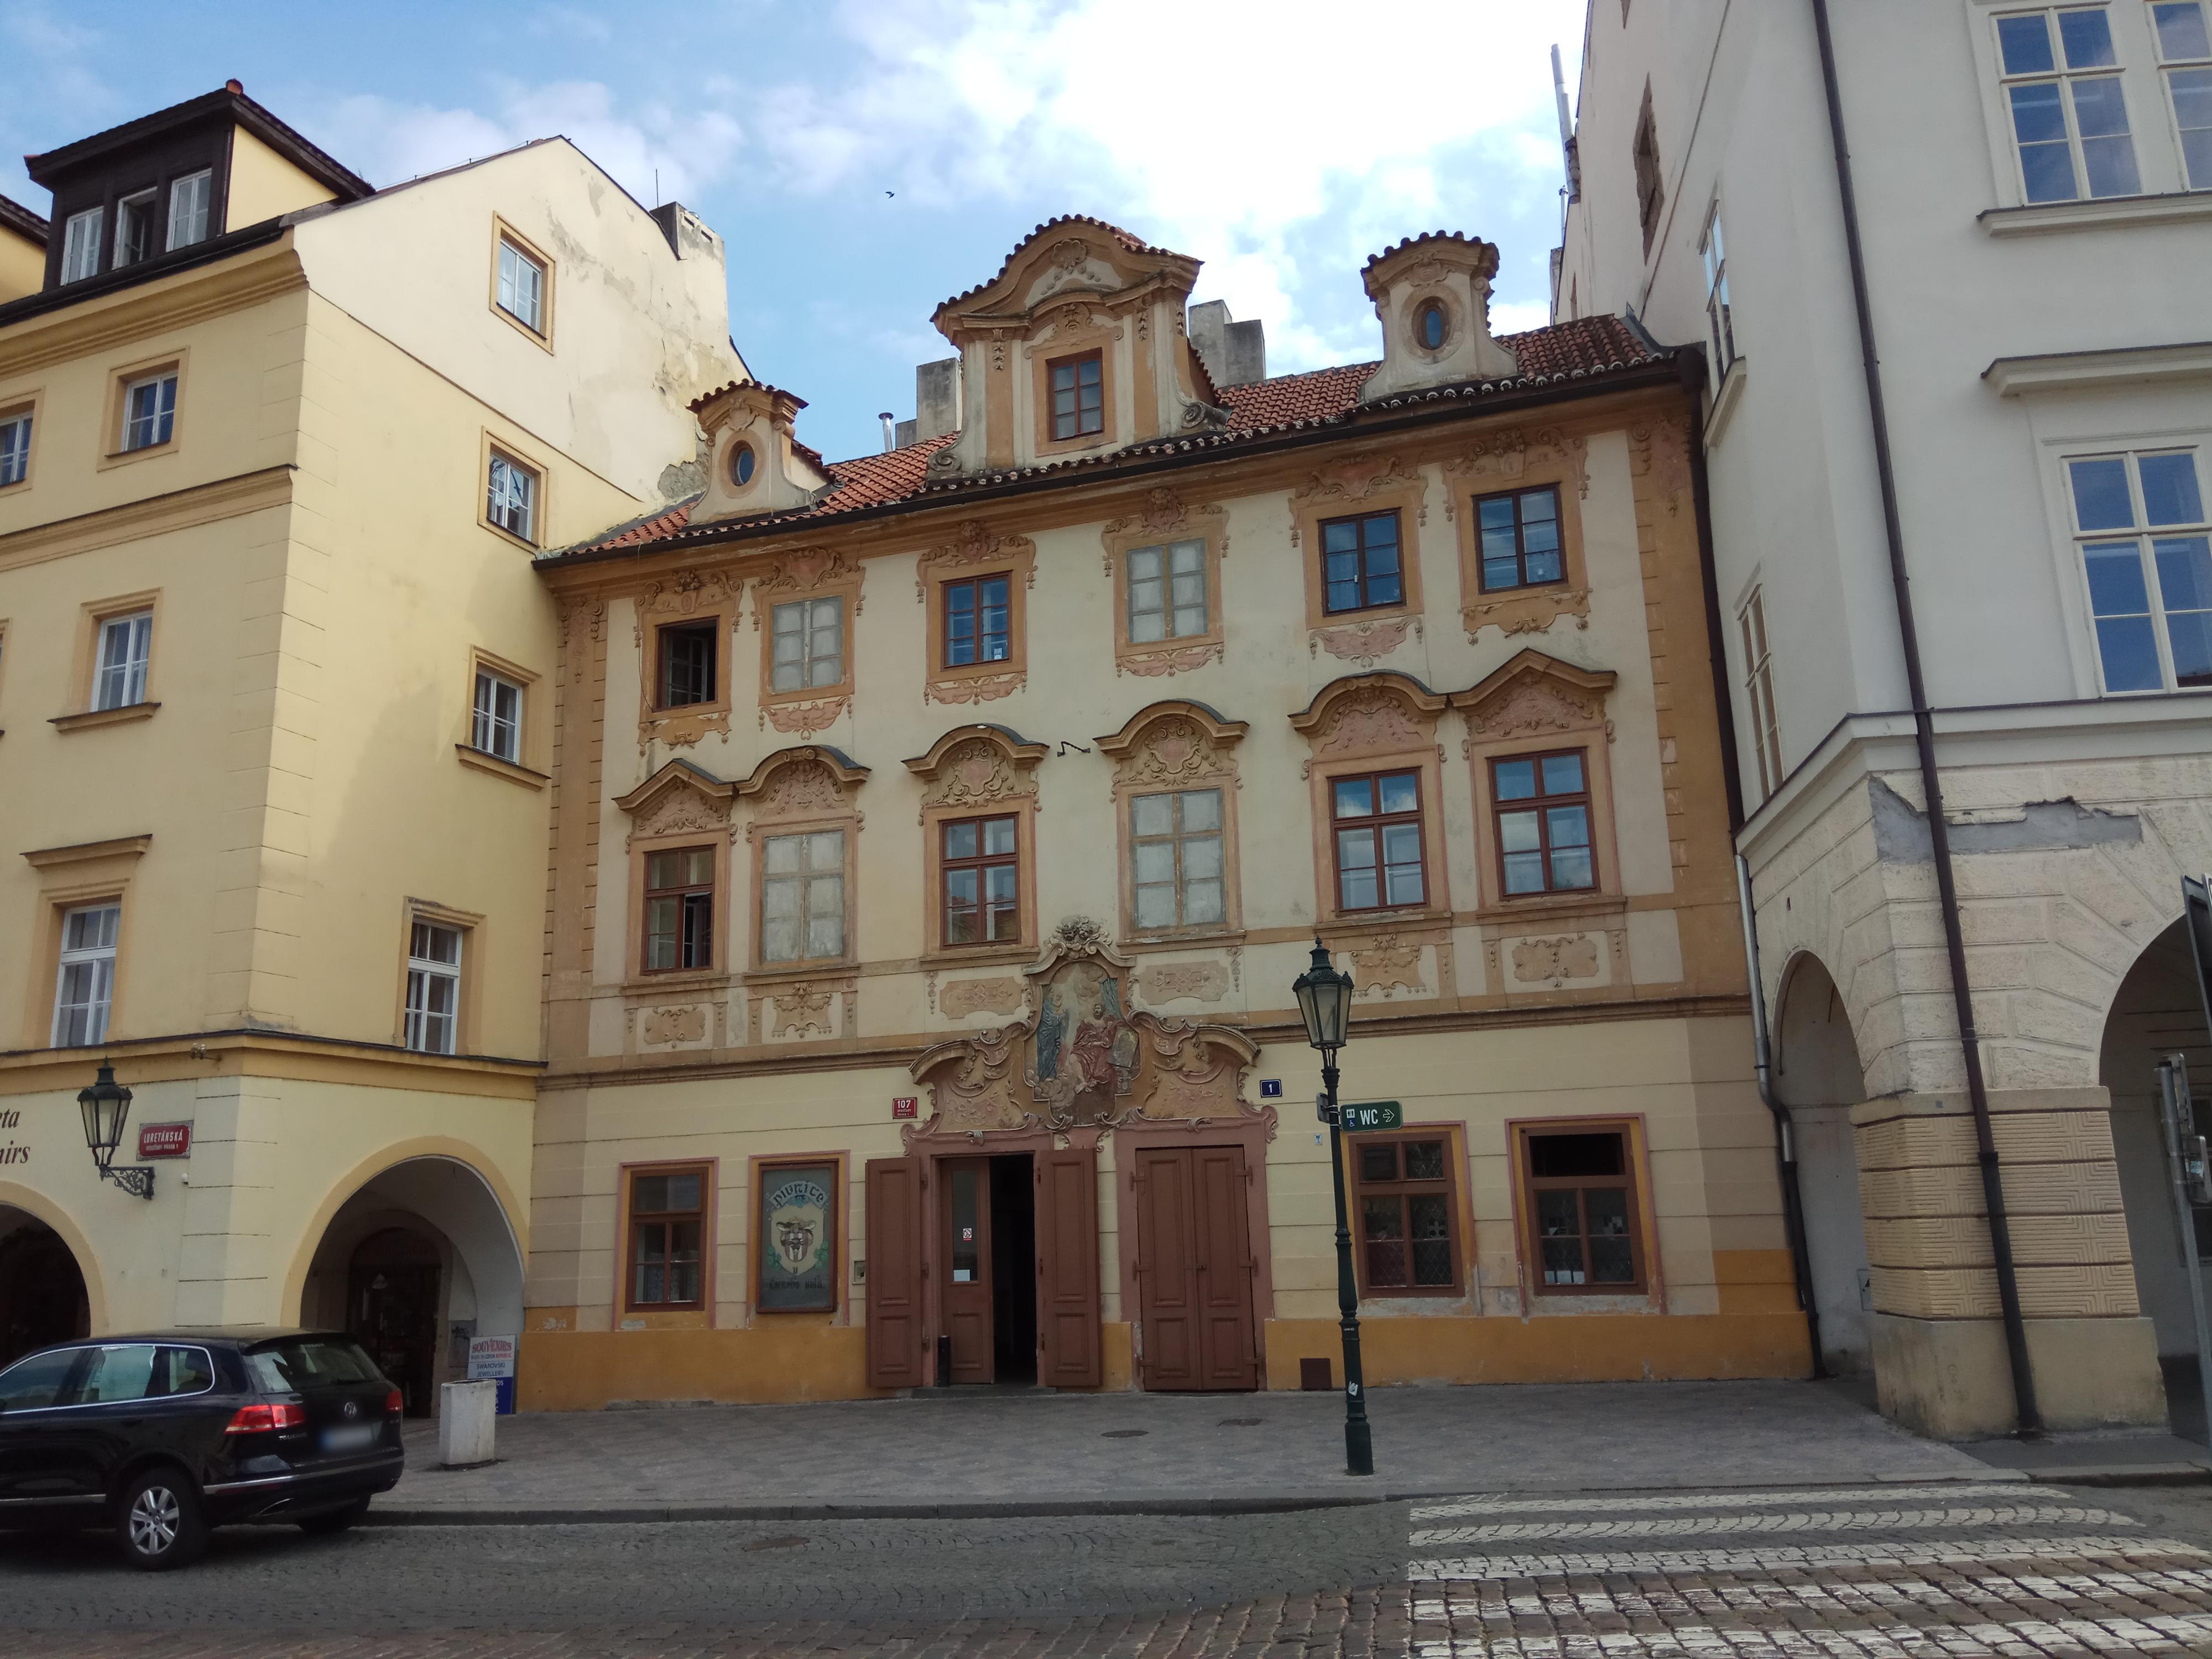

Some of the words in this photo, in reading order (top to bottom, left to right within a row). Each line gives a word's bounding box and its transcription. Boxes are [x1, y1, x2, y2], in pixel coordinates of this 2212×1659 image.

[1268, 1083, 1274, 1093] 1
[898, 1100, 911, 1108] 107
[1359, 1109, 1379, 1125] WC
[144, 1129, 183, 1144] LORETÁNSKÁ
[472, 1338, 512, 1353] SOUVENIRS
